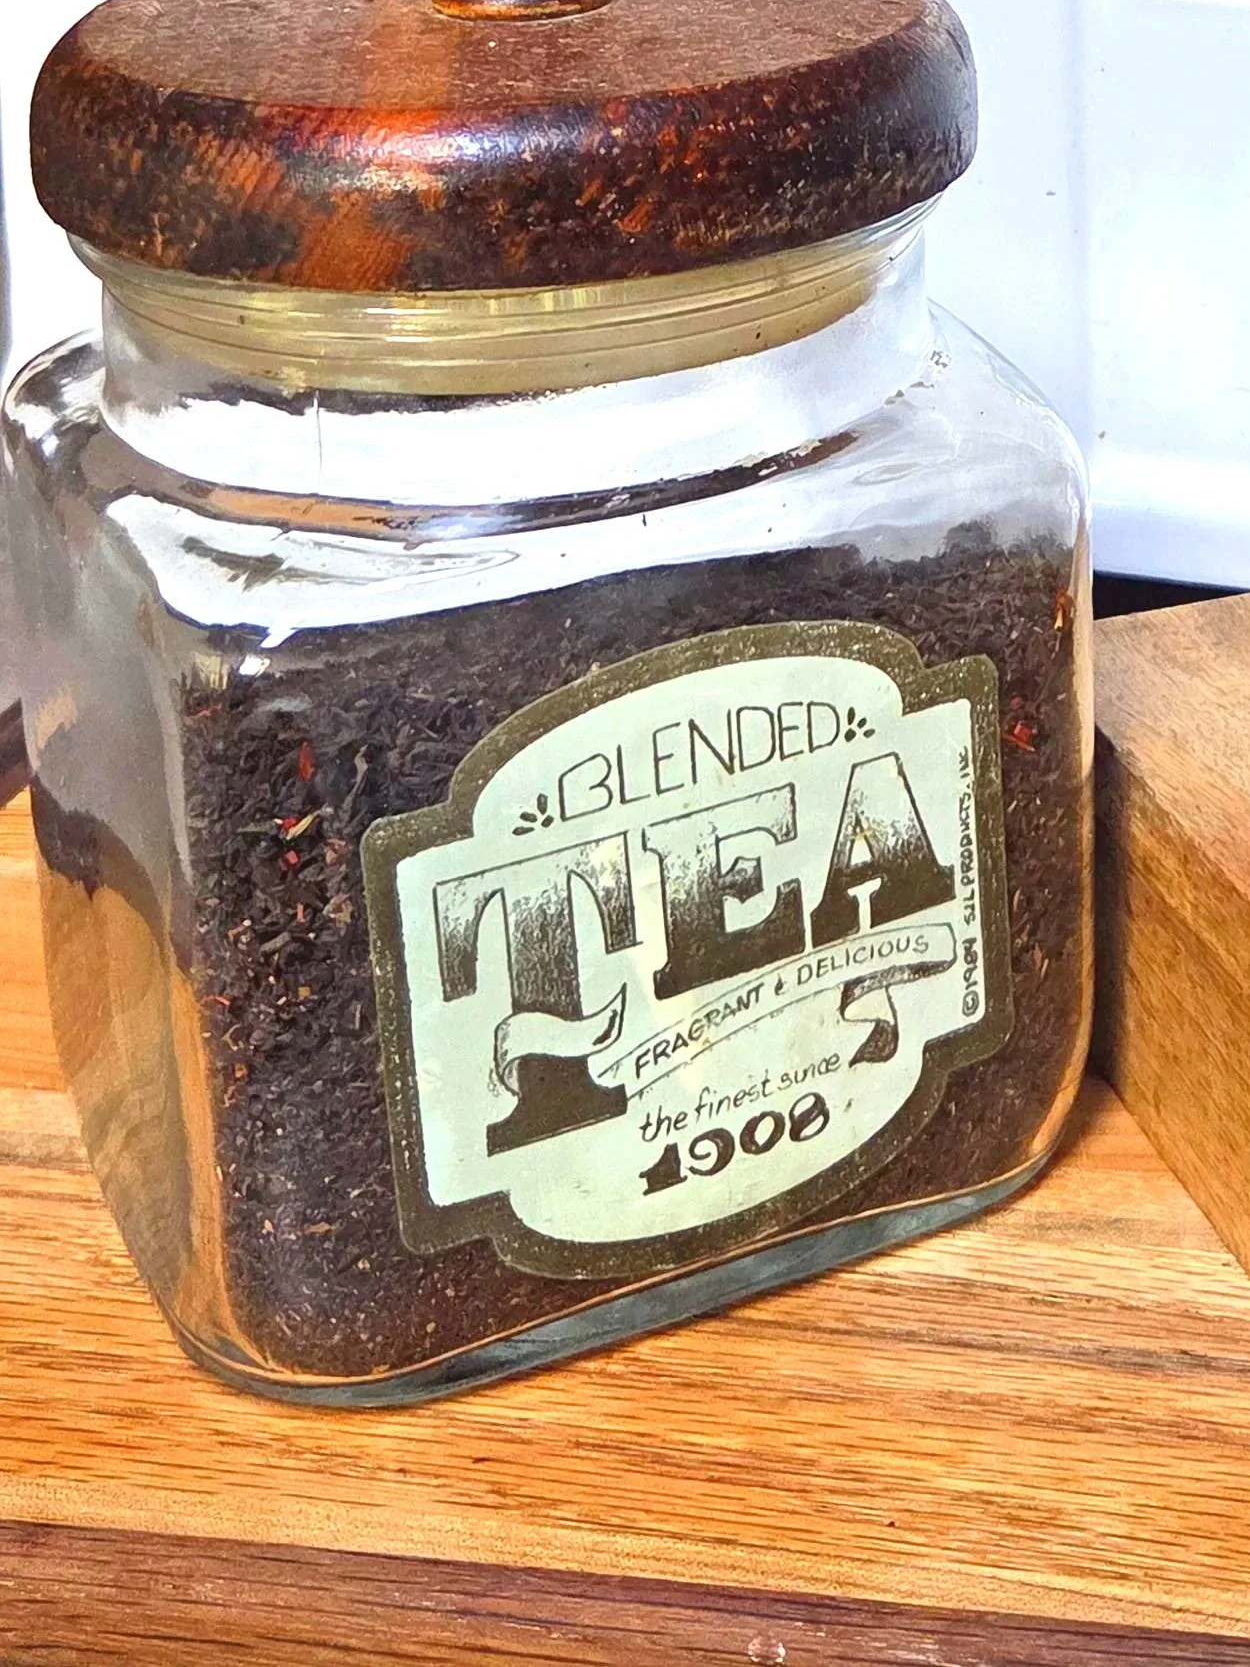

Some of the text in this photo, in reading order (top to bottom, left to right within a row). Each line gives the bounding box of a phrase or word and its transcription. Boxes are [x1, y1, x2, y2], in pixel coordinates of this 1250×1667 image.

[557, 701, 841, 822] BLENDED
[433, 752, 957, 1157] TEA
[634, 982, 765, 1080] FRAGRANT
[796, 934, 930, 987] DELICIOUS
[638, 1045, 842, 1143] the finest since
[638, 1091, 831, 1197] 1908
